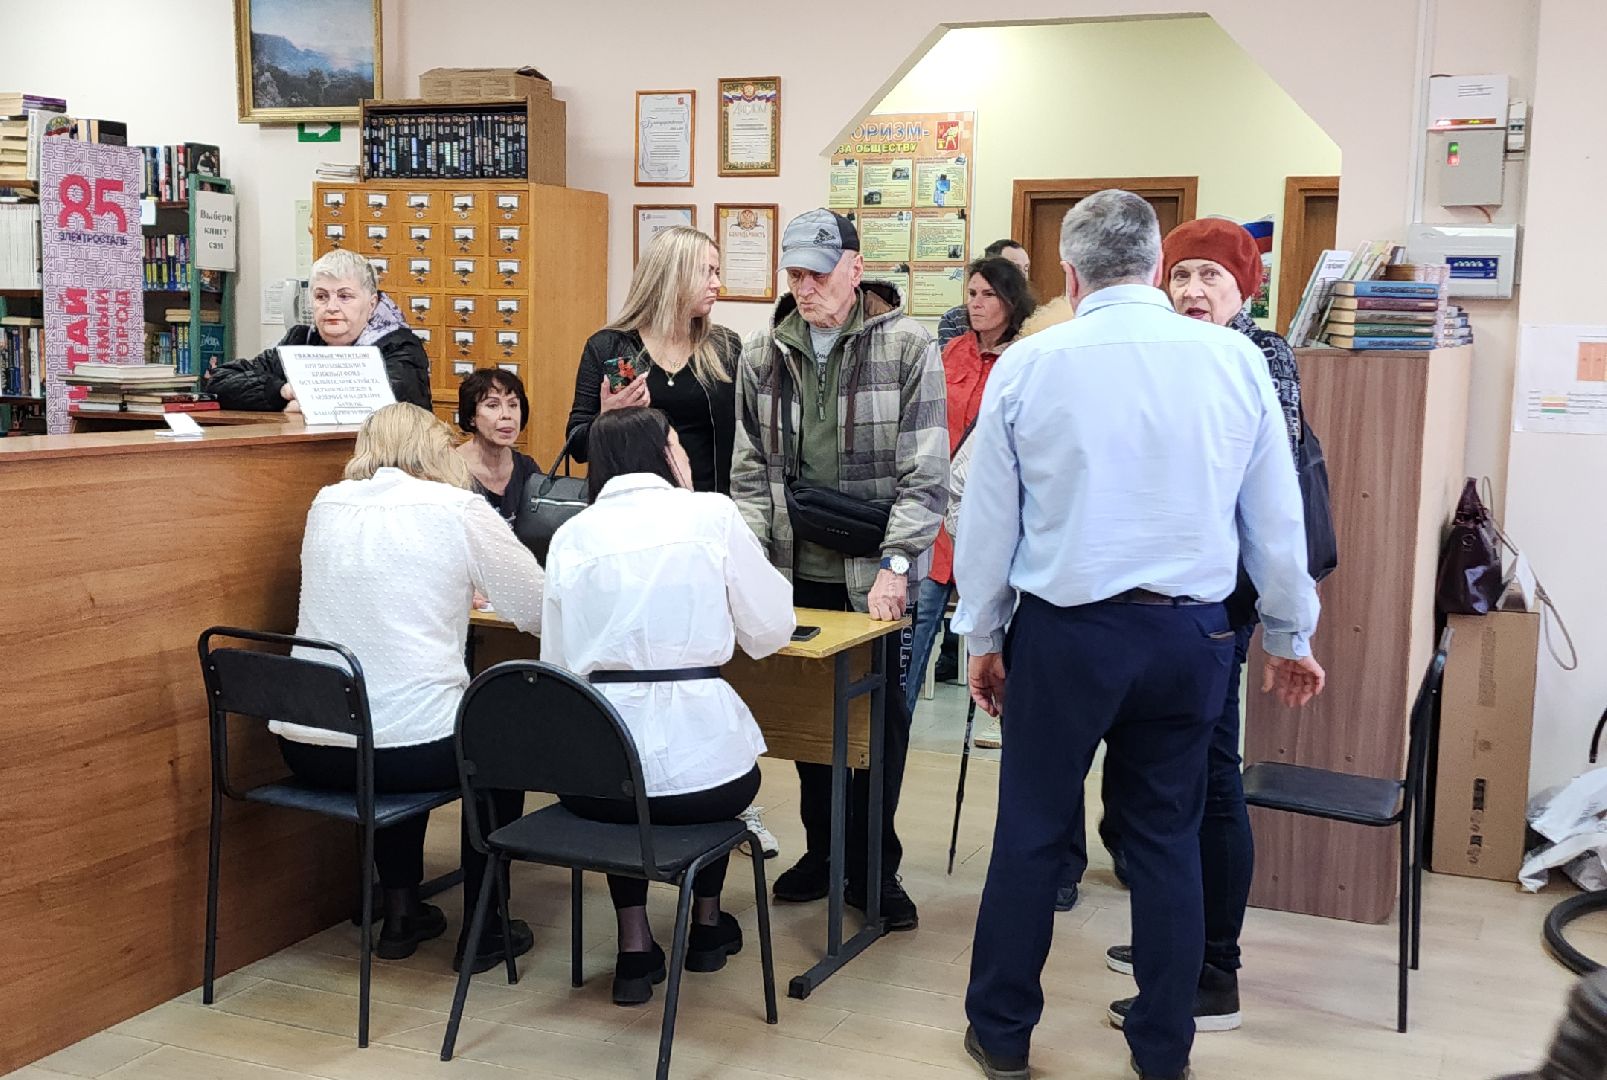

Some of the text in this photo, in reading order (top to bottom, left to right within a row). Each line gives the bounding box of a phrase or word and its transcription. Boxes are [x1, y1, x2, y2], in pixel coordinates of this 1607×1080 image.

[855, 142, 918, 155] ОБЩЕСТВУ
[58, 174, 127, 233] 85
[200, 209, 232, 223] Выбери
[59, 231, 128, 246] ЭЛЕКТРОСТАЛЬ
